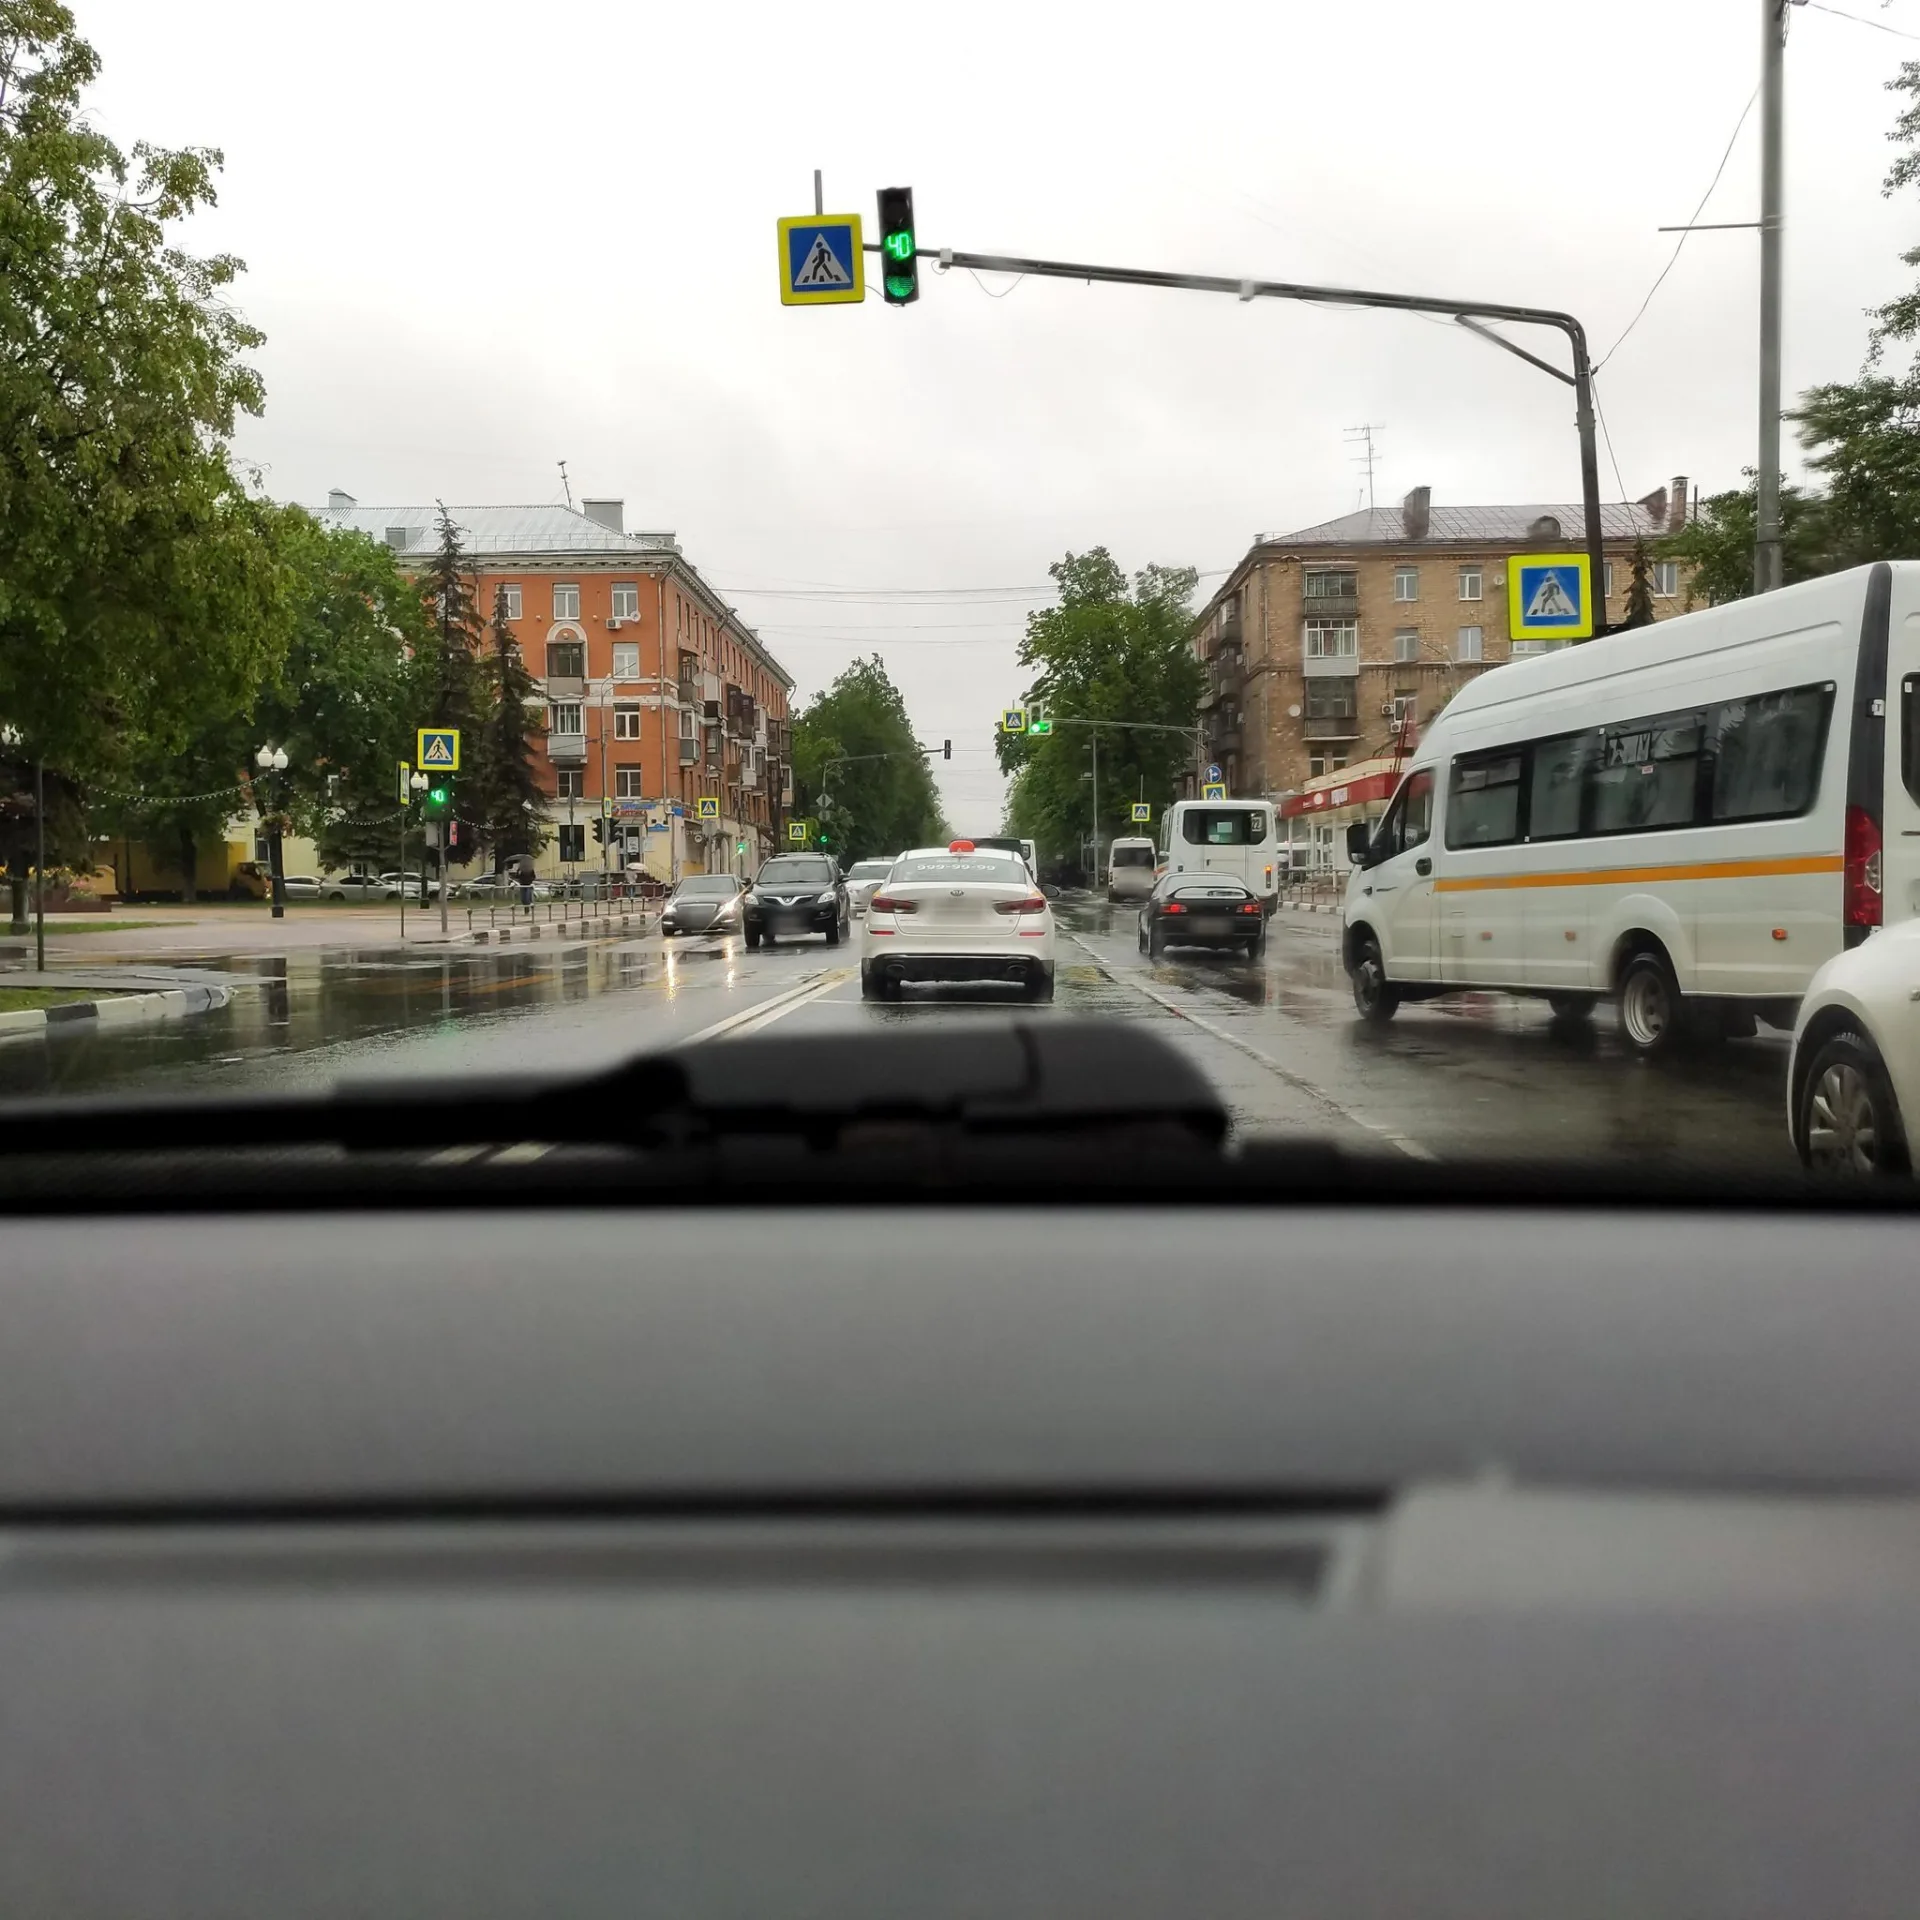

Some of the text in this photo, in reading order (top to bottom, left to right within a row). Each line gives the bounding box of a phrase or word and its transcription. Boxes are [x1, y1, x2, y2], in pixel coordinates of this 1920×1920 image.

[887, 233, 910, 258] 40
[430, 790, 444, 802] 40
[917, 863, 996, 871] 999-99-99
